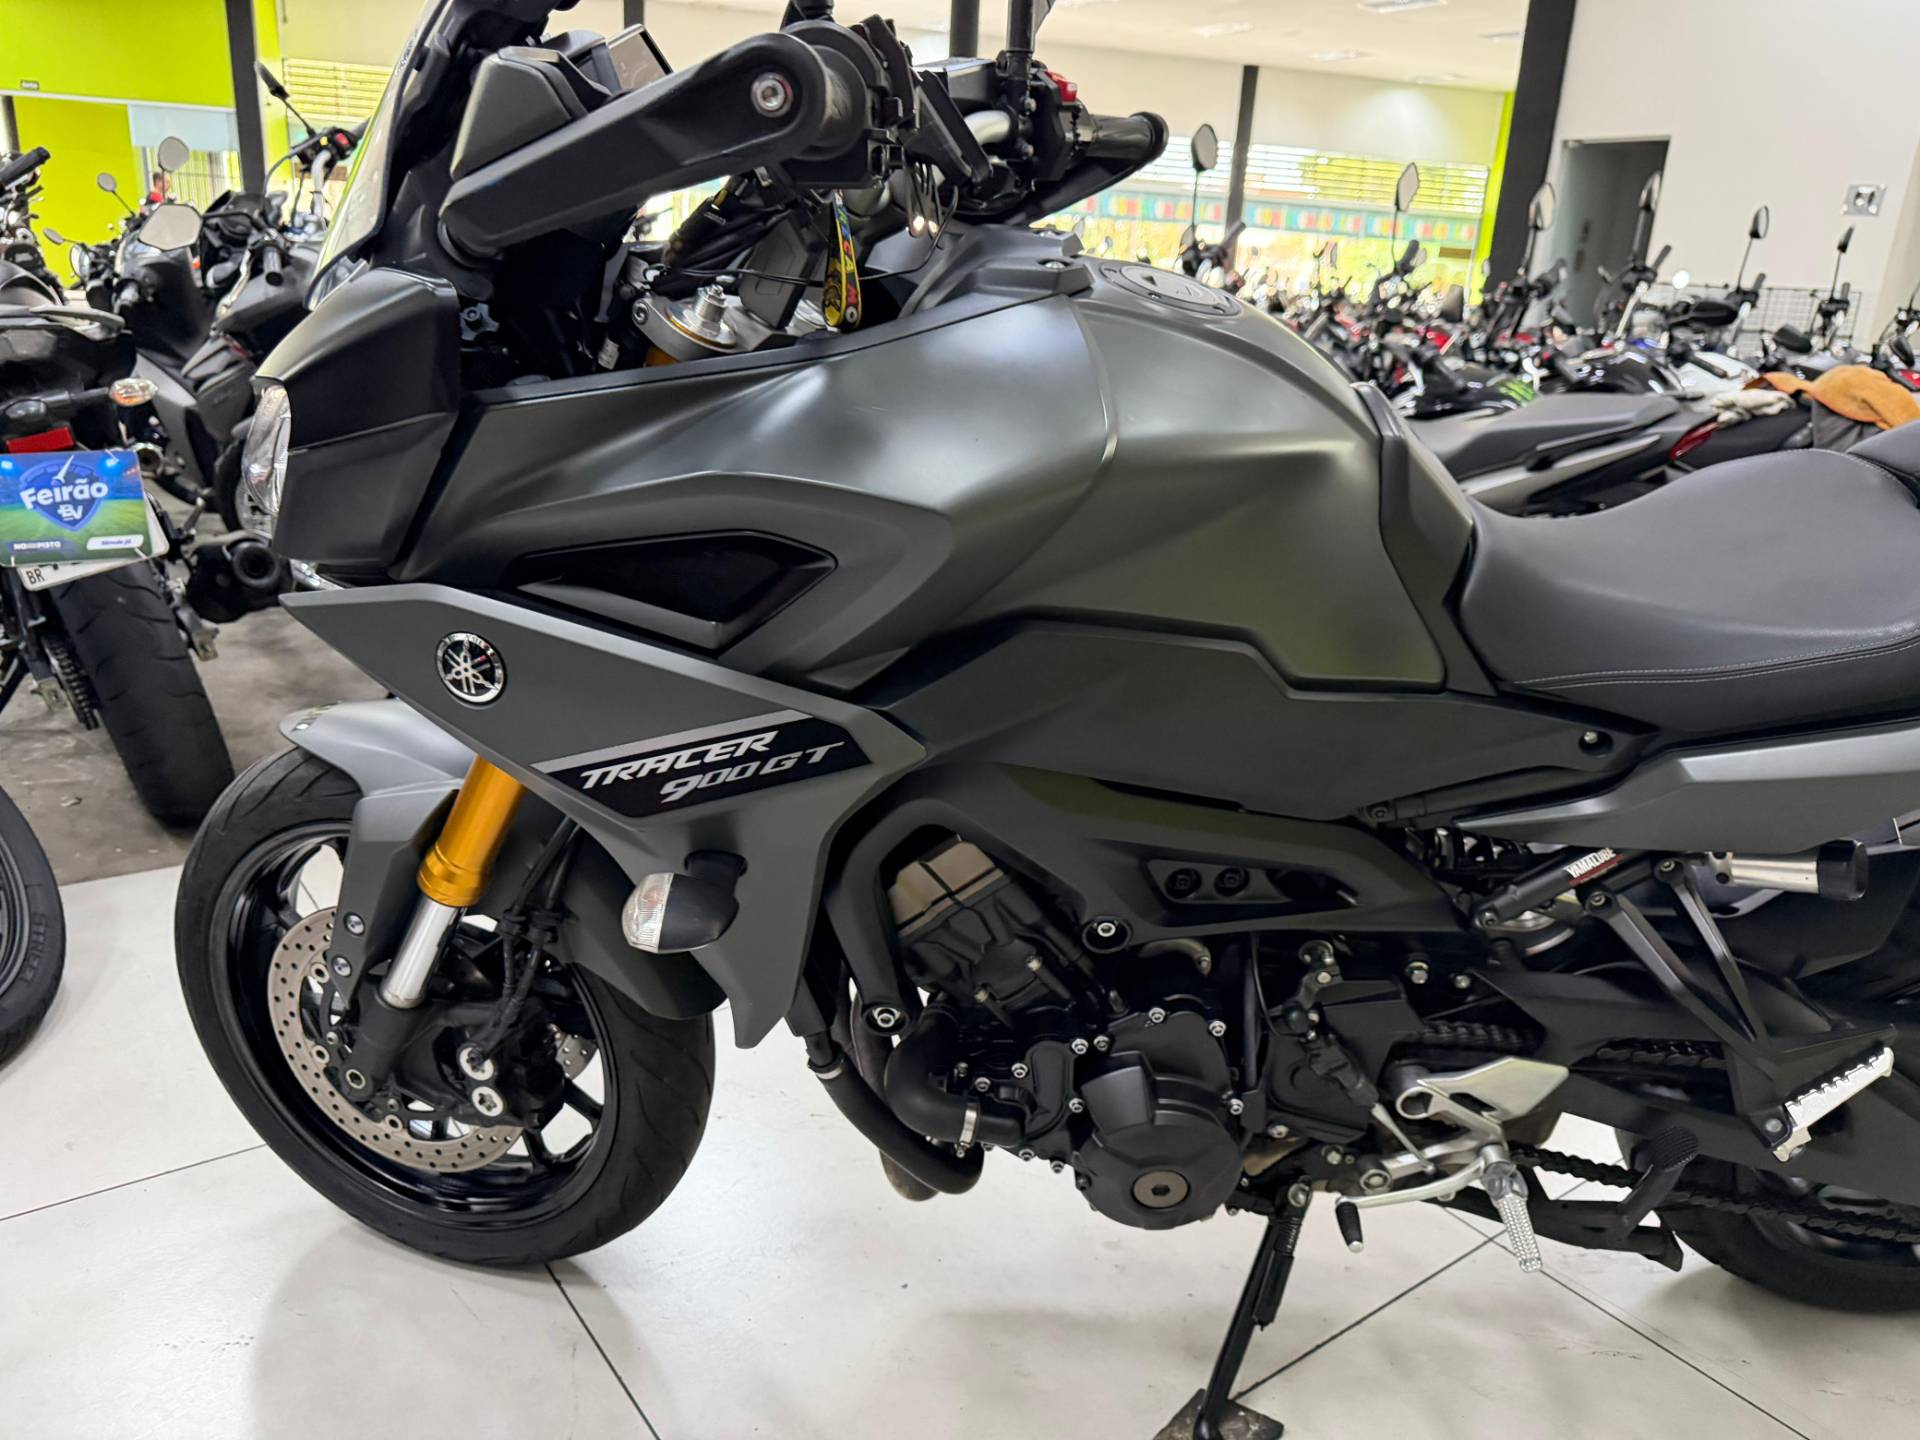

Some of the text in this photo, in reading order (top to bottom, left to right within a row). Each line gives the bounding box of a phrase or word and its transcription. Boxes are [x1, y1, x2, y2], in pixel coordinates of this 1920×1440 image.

[19, 478, 109, 510] Feirão
[26, 568, 45, 585] BR
[580, 730, 779, 790] TRACER
